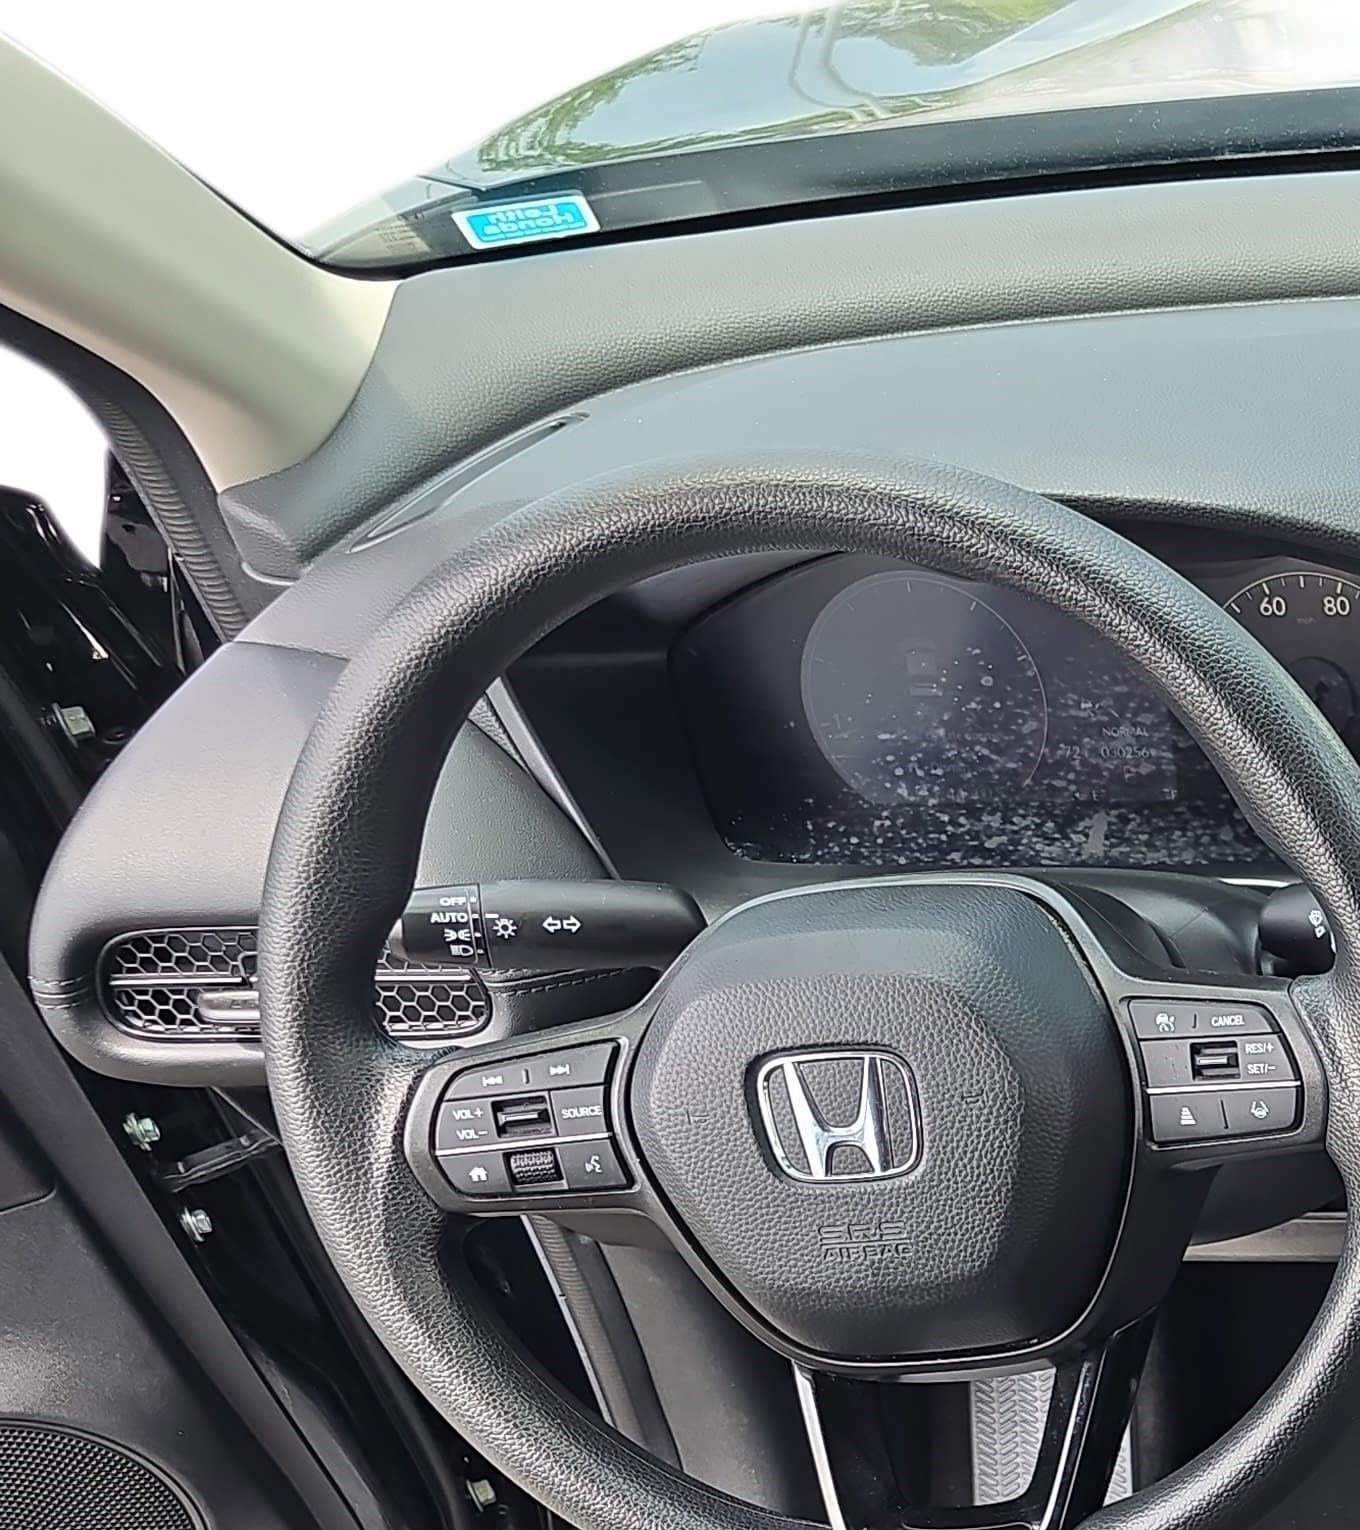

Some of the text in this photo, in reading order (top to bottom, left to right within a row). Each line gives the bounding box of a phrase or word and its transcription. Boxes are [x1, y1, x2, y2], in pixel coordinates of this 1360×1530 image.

[1259, 597, 1288, 617] 60
[1323, 597, 1350, 617] 80
[1102, 727, 1150, 737] NORMAL
[439, 896, 466, 907] OFF
[430, 912, 468, 923] AUTO
[1211, 1015, 1245, 1027] CANCEL
[1245, 1043, 1274, 1055] RES/+
[562, 1105, 603, 1119] SOURCE
[818, 1219, 907, 1241] SRS
